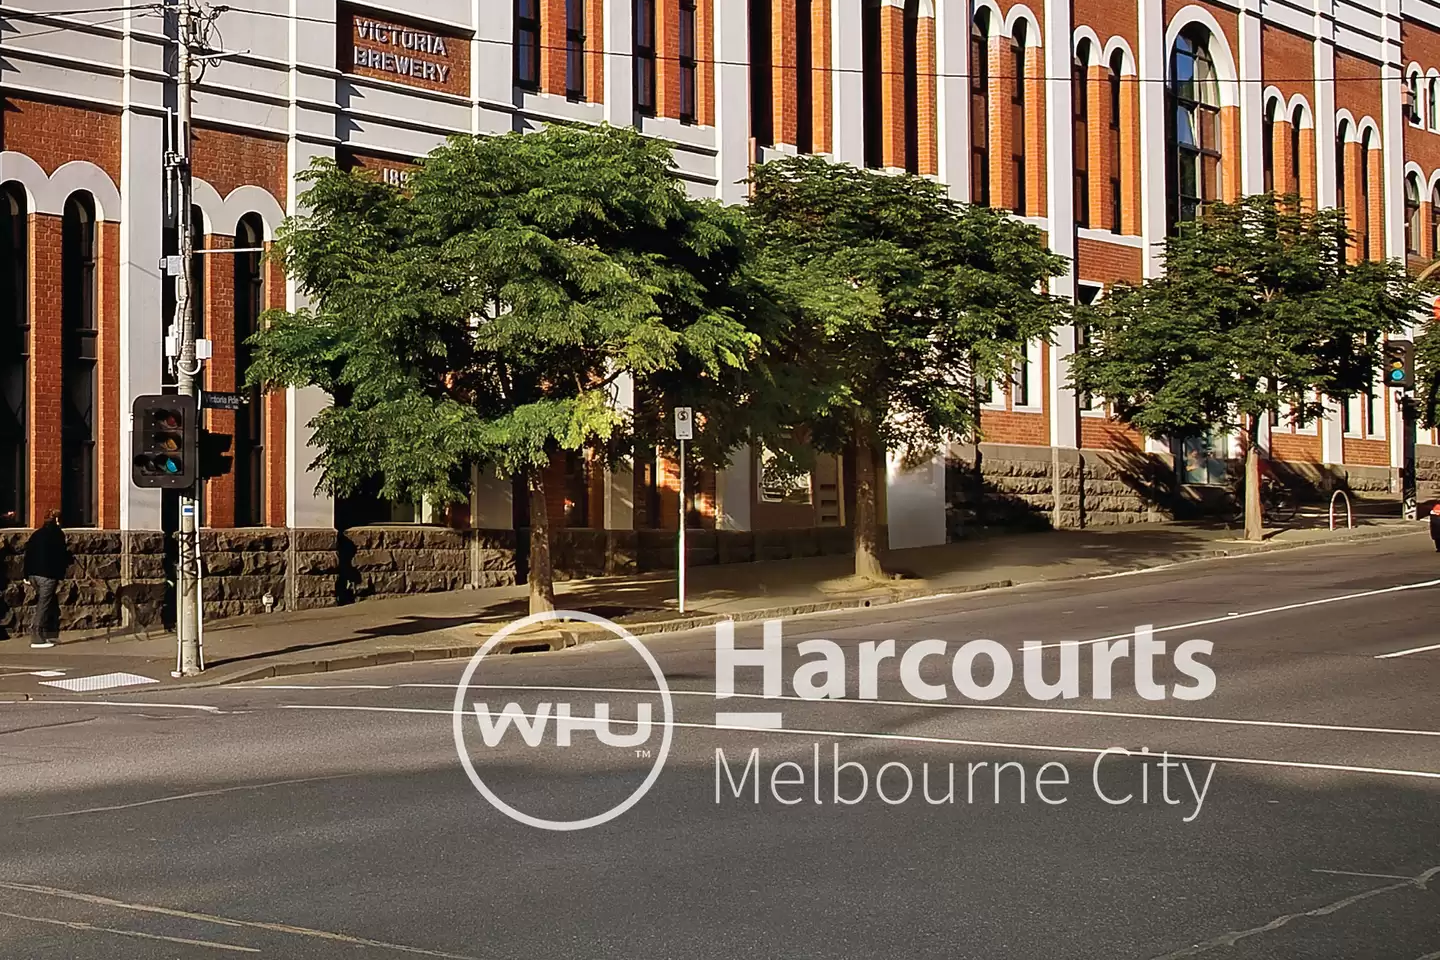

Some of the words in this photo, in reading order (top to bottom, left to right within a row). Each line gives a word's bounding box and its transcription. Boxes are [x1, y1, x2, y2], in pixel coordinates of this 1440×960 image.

[356, 18, 447, 56] VICTORIA
[354, 45, 450, 83] BREWERY
[383, 167, 409, 188] 189
